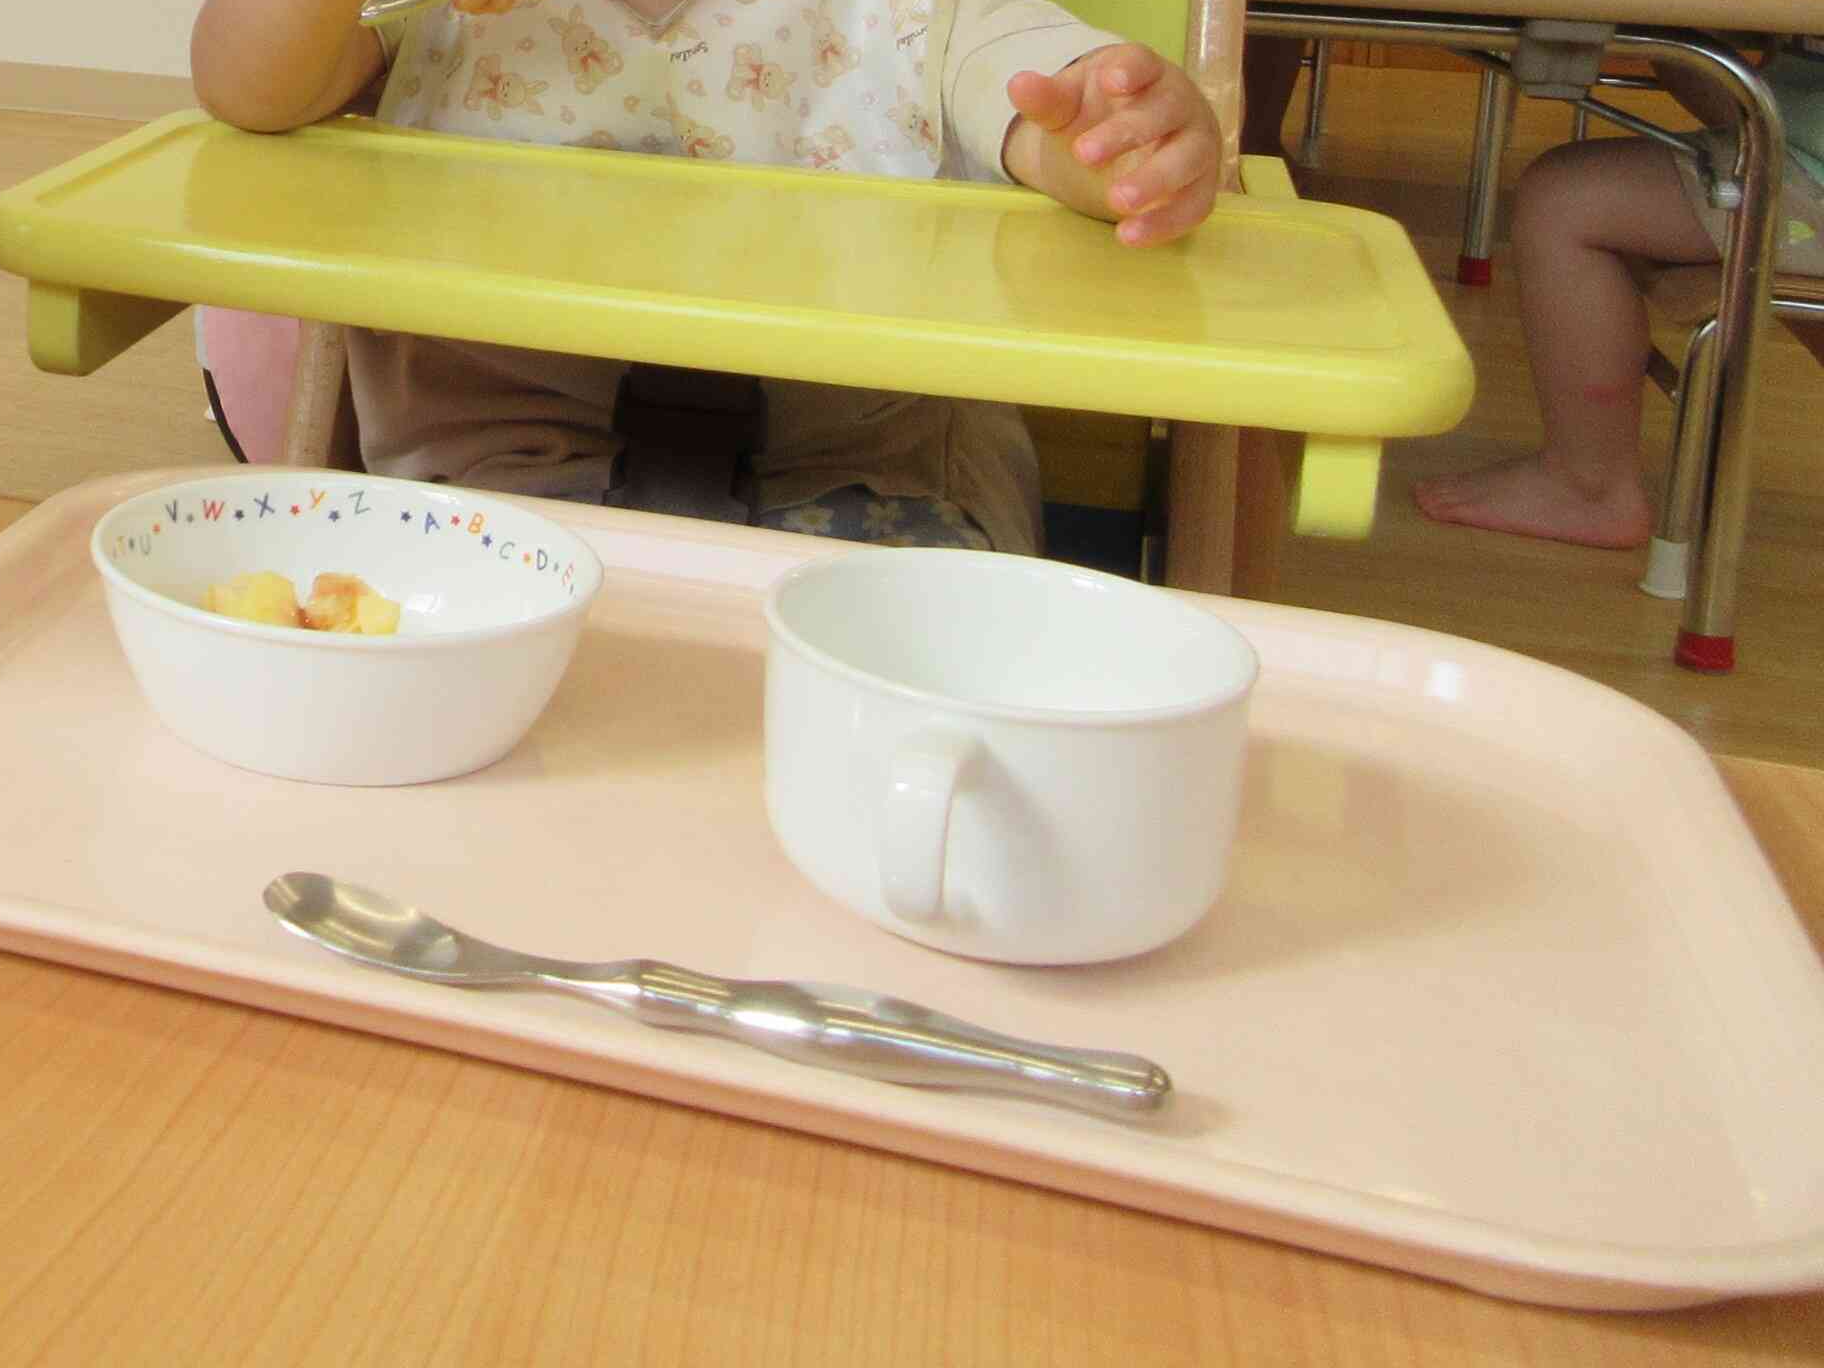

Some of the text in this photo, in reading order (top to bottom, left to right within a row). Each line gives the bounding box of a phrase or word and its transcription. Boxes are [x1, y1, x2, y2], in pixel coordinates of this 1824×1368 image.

[165, 499, 179, 523] V
[202, 498, 226, 522] W
[253, 492, 276, 519] X
[310, 488, 326, 510] Y
[348, 490, 372, 515] Z
[424, 512, 440, 534] A
[467, 512, 485, 534] B
[498, 541, 516, 560] C
[536, 549, 548, 571] D
